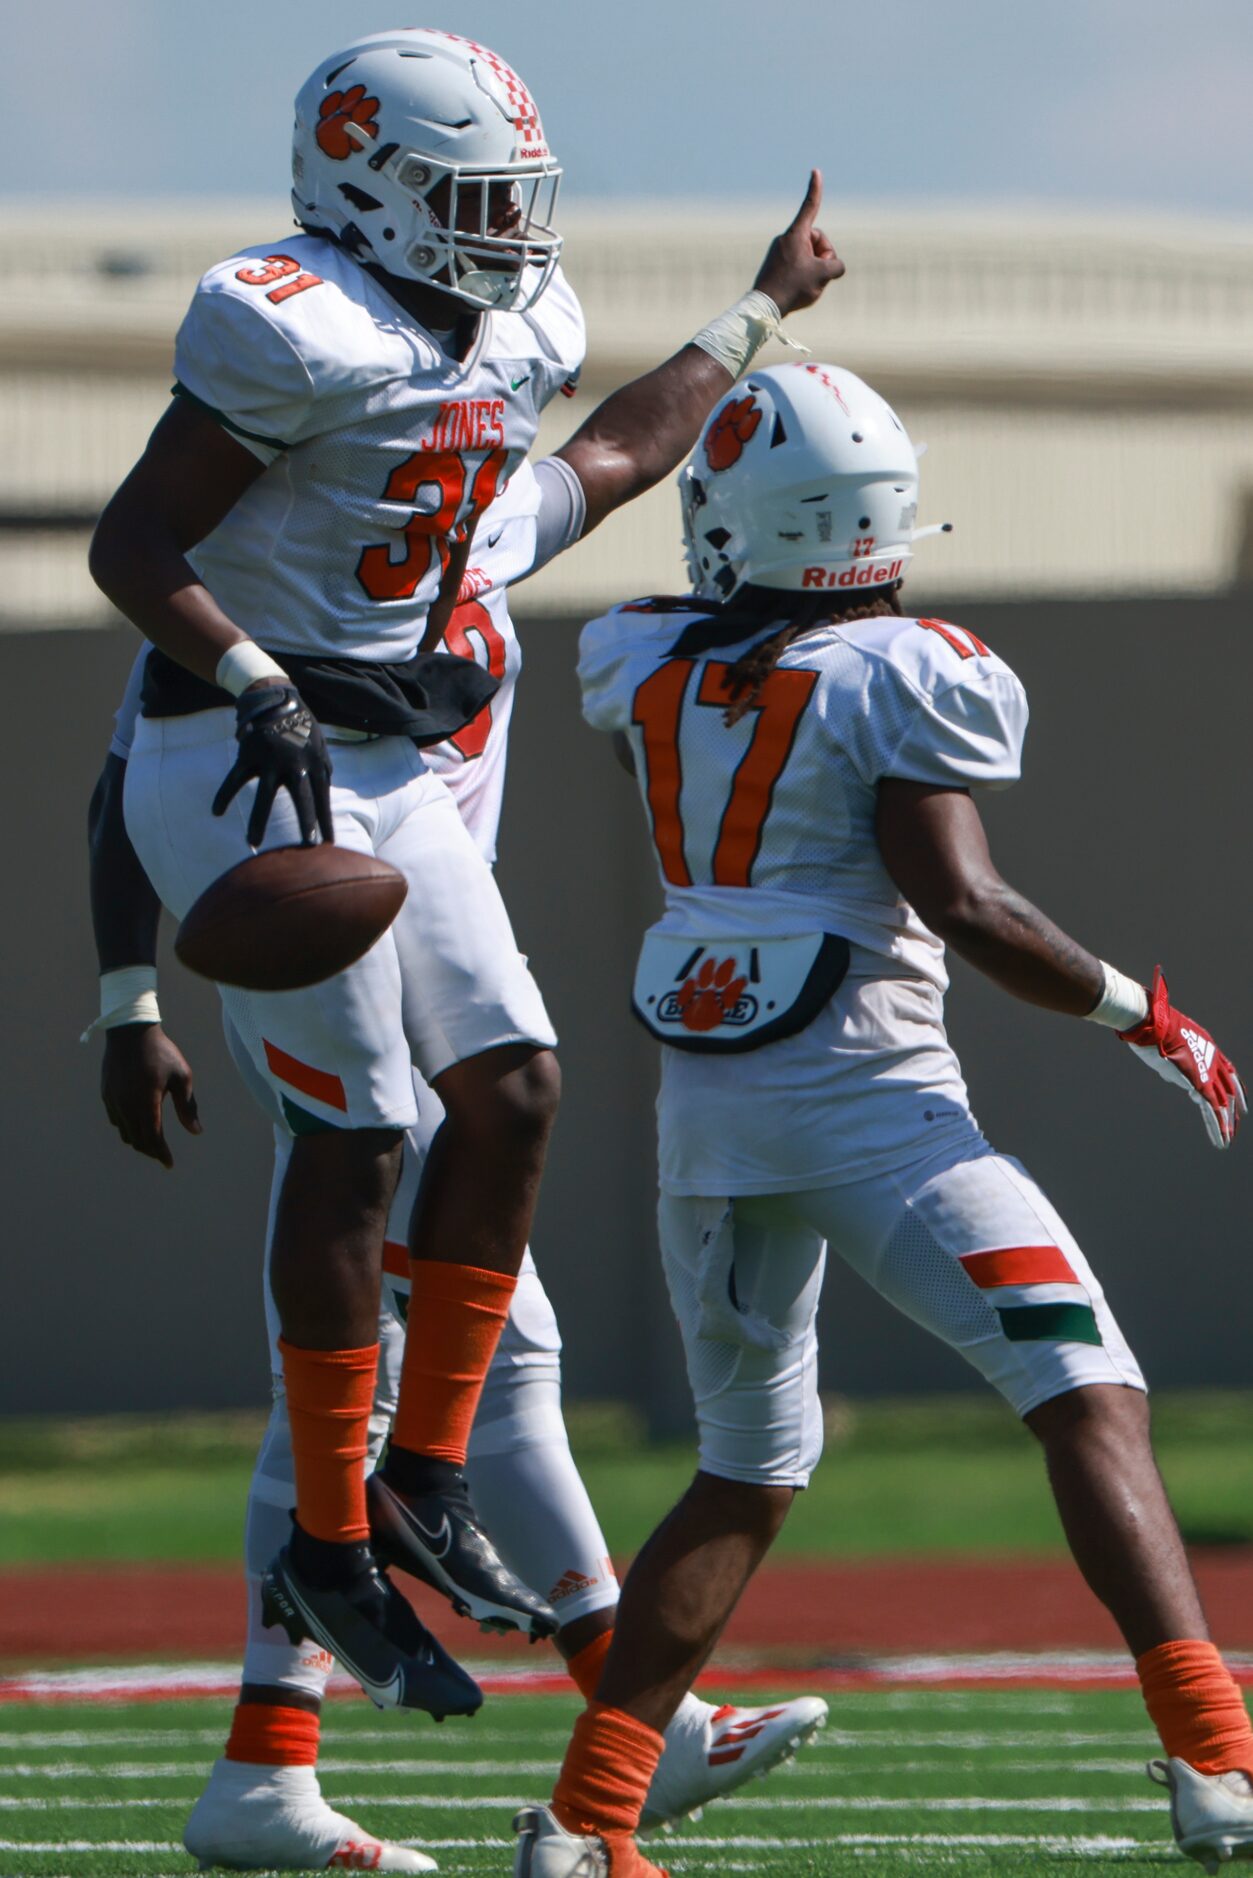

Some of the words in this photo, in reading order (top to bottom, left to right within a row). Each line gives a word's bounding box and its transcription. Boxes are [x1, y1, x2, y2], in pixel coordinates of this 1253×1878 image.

[235, 254, 324, 305] 31
[421, 400, 505, 451] JONES
[852, 537, 875, 557] 17
[801, 560, 902, 587] Riddell
[631, 657, 822, 887] 17
[1180, 1028, 1209, 1084] adidas
